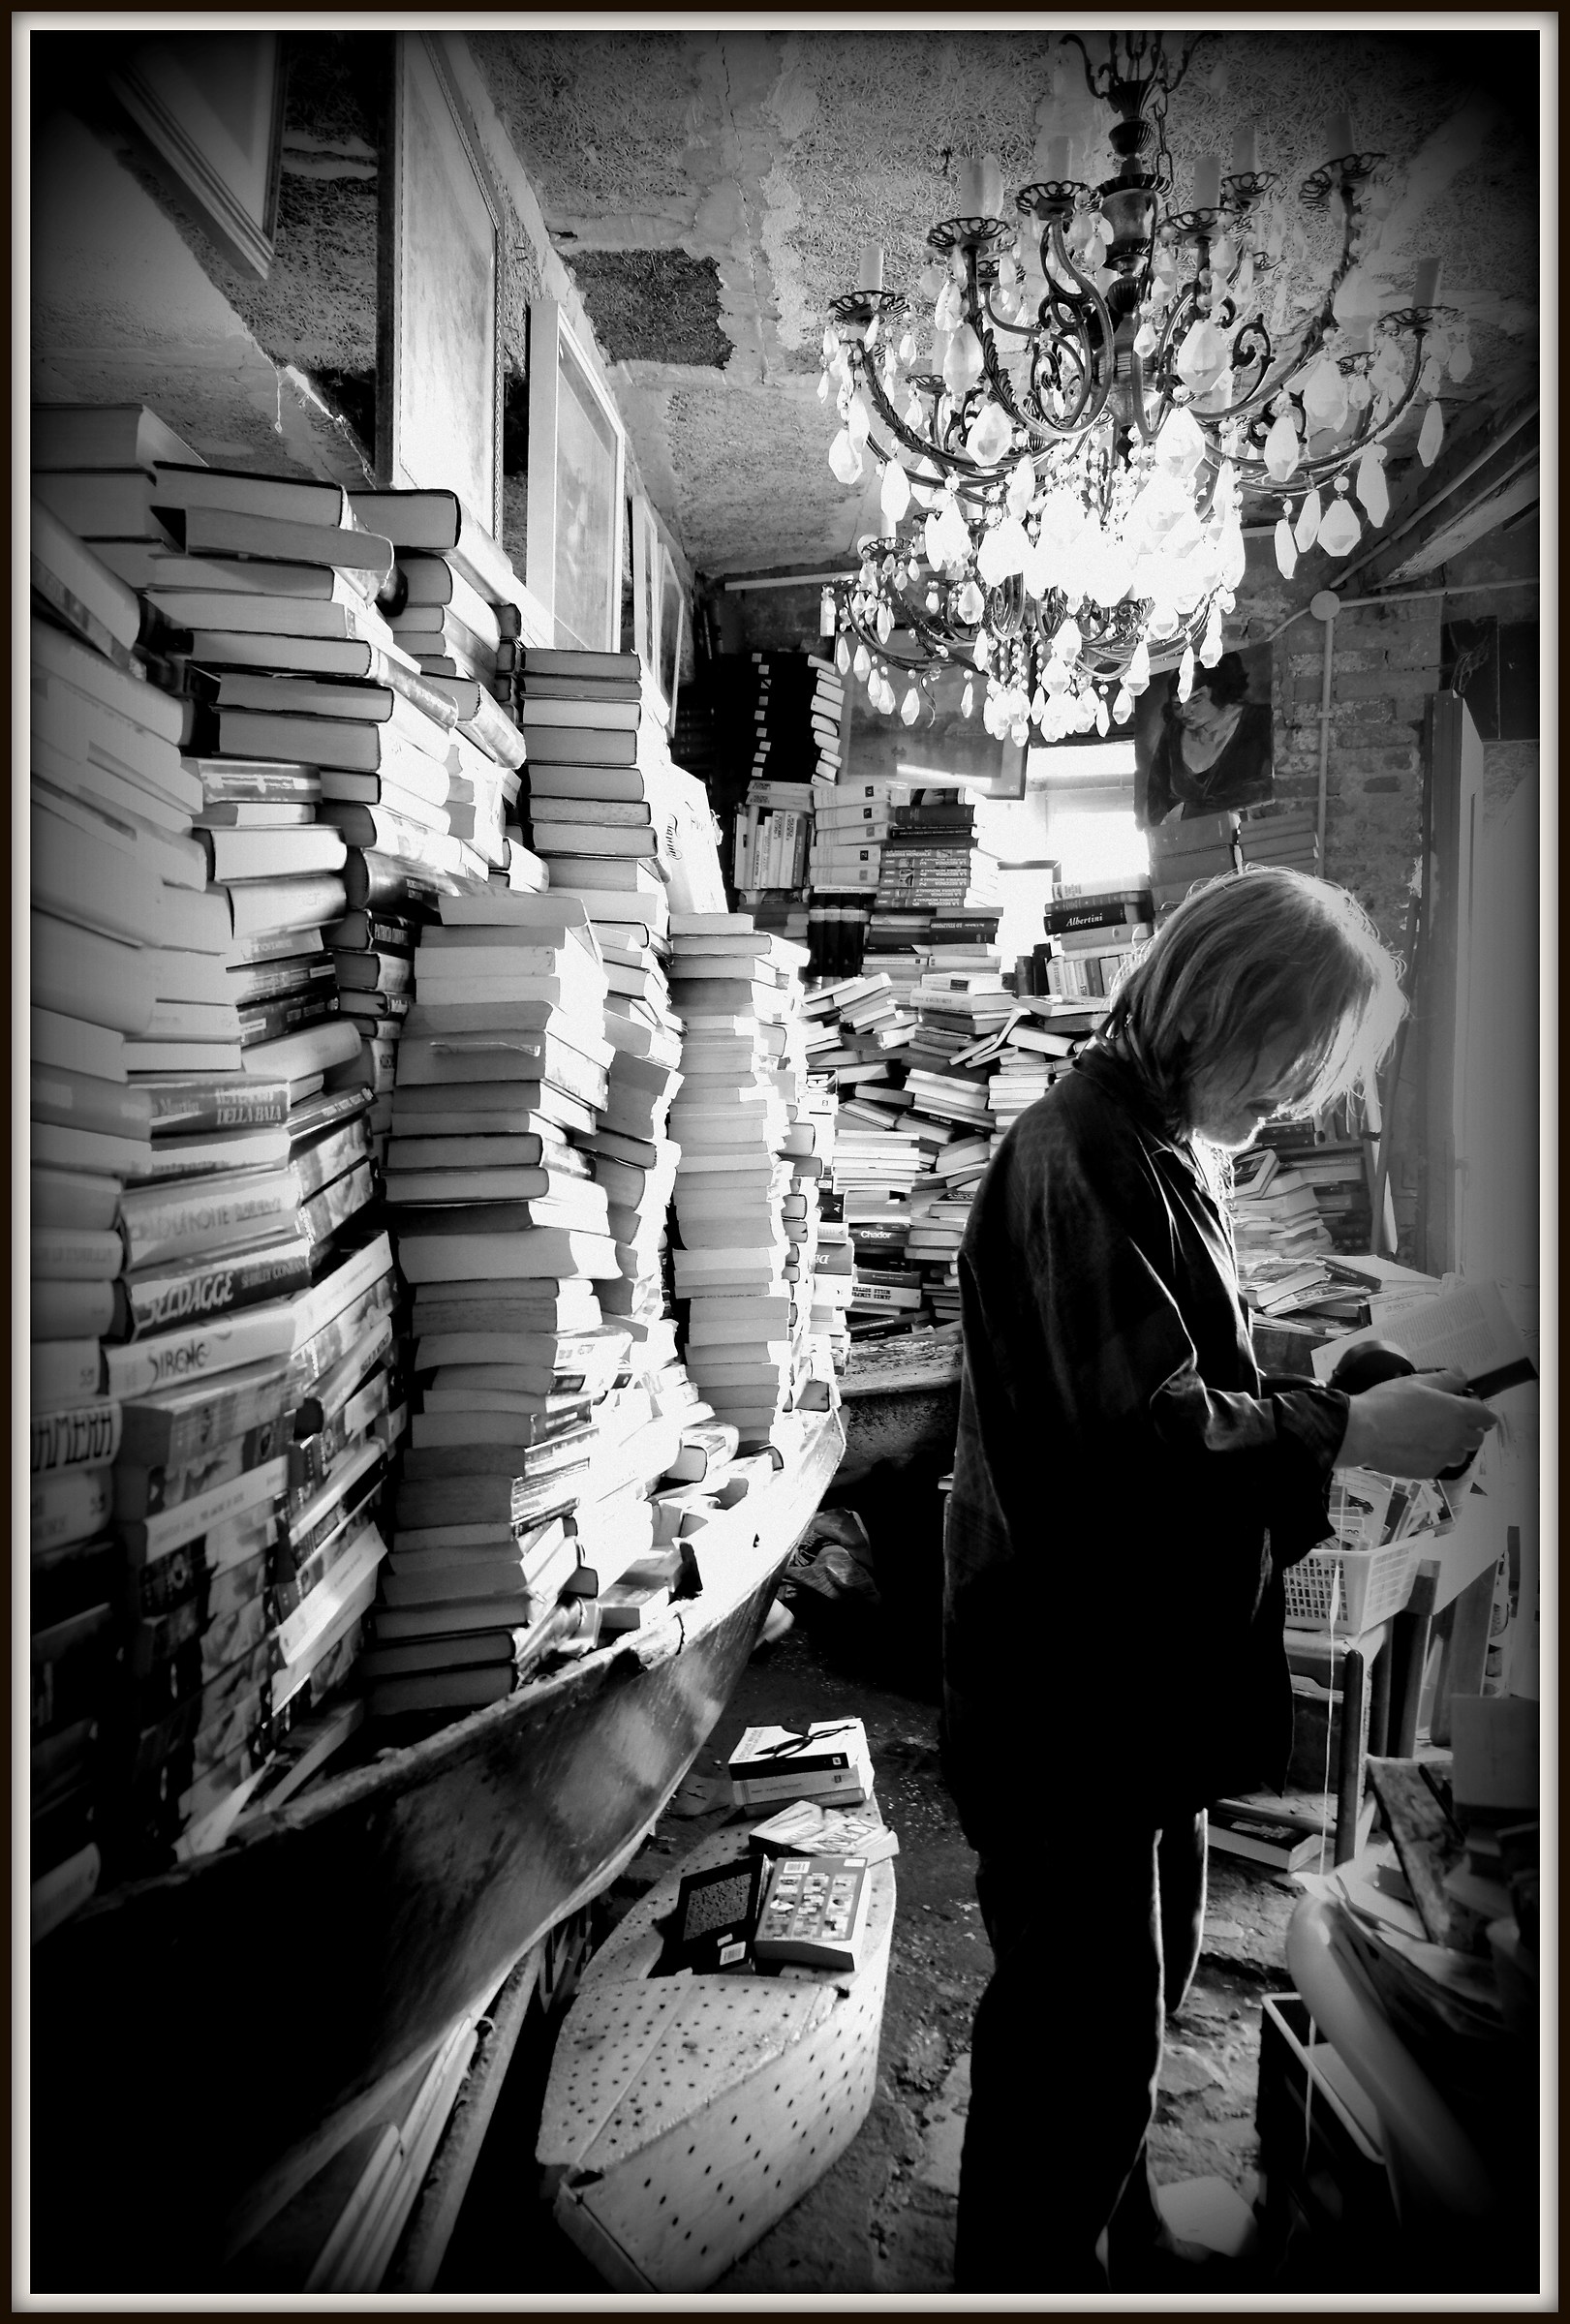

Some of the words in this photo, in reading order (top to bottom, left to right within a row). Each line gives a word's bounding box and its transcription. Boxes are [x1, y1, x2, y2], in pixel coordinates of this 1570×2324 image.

[1065, 912, 1103, 927] Albertini
[216, 1107, 254, 1125] DELLA
[255, 1105, 282, 1122] BAIA
[860, 1230, 892, 1238] Chador
[147, 1340, 207, 1389] SIRENE
